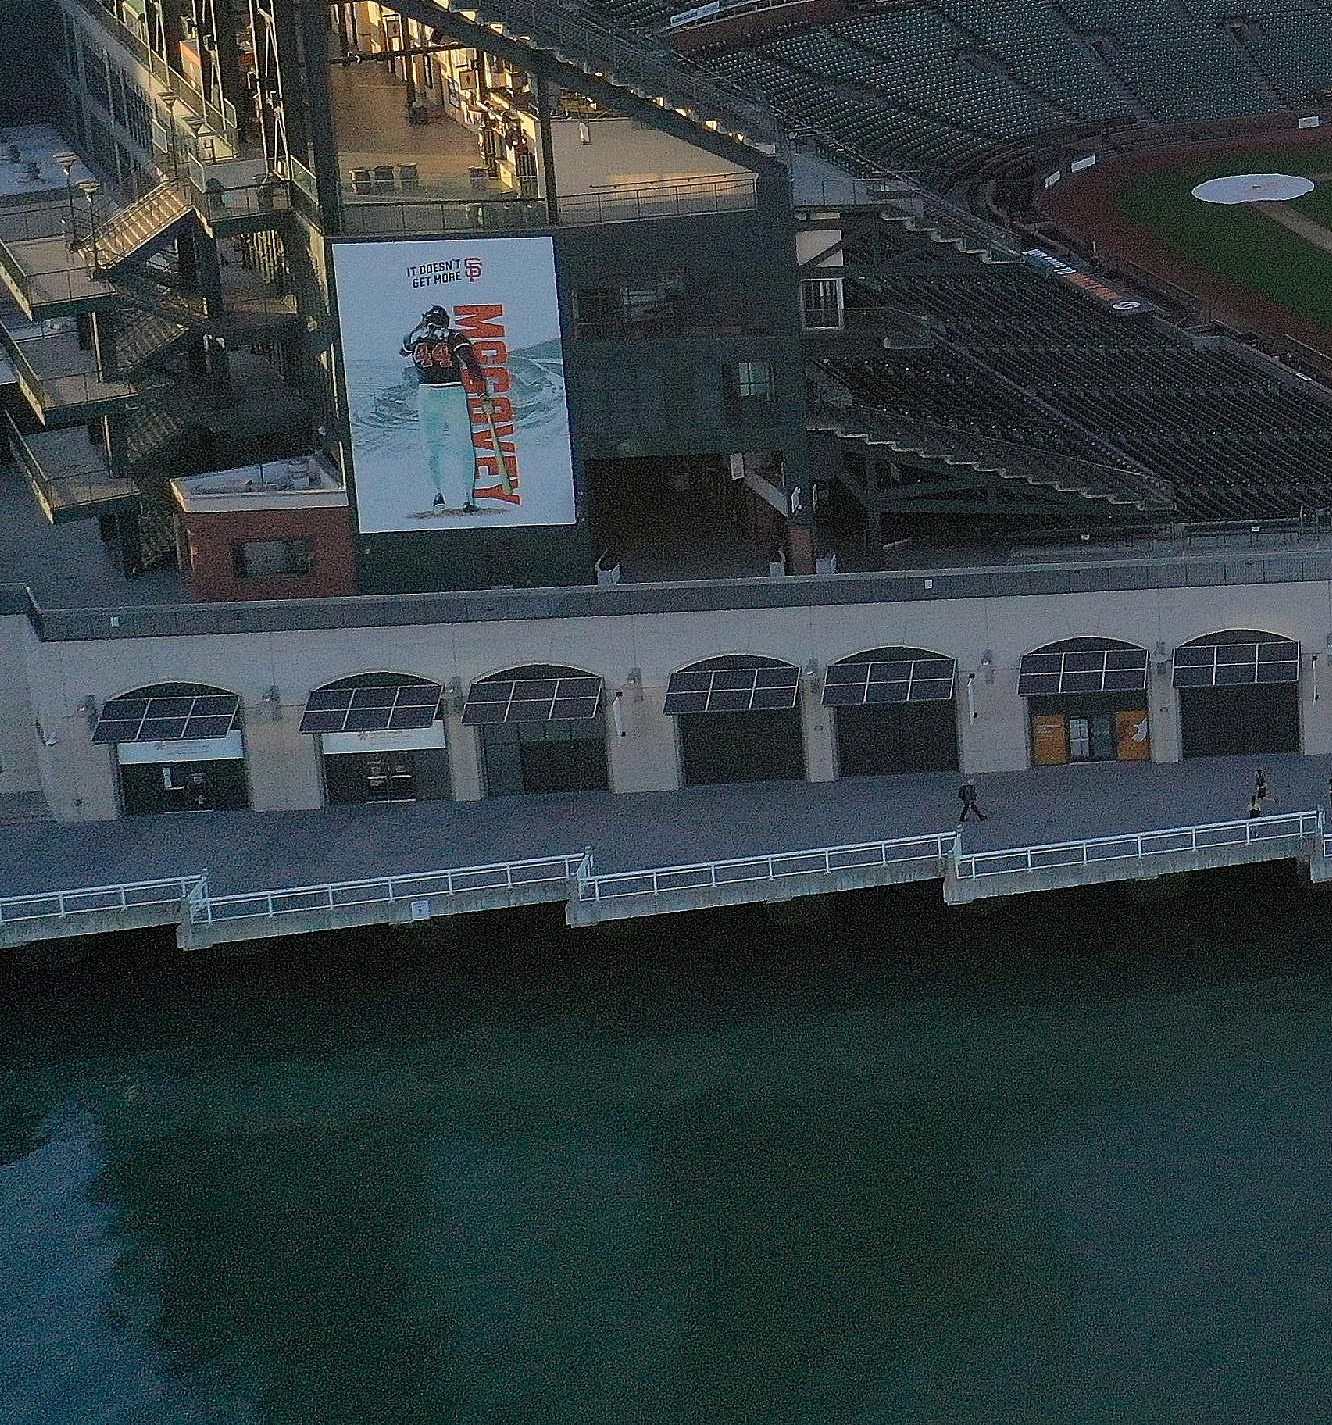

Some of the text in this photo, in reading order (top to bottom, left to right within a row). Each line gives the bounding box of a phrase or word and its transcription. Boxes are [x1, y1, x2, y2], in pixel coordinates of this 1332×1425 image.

[406, 258, 460, 277] IT DOESN'T
[413, 271, 461, 288] GET MORE
